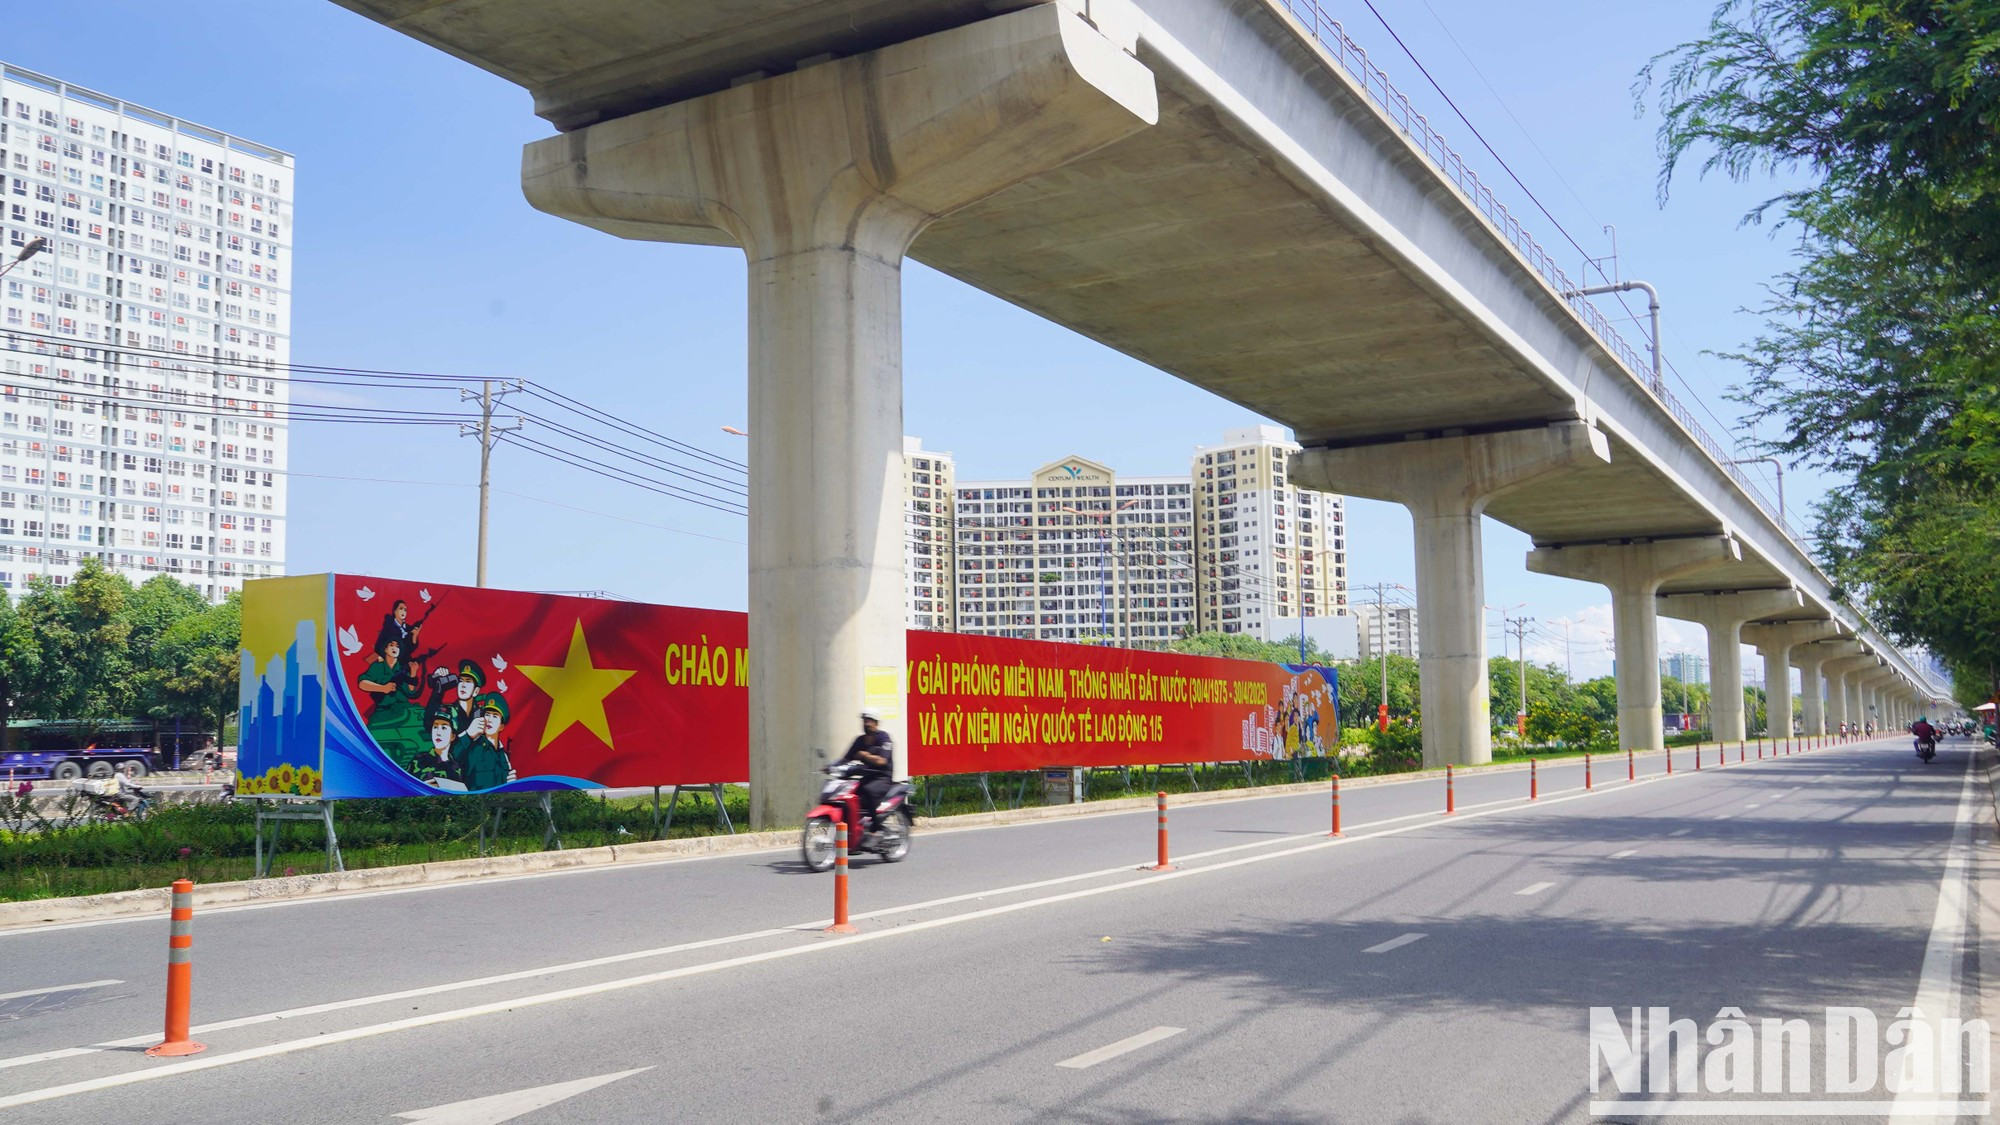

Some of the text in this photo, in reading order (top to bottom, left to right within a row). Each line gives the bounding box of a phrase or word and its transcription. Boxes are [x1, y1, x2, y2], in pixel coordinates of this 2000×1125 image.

[665, 634, 728, 687] CHÀO
[918, 653, 947, 695] GIẢI
[952, 655, 1000, 696] PHÓNG
[1004, 659, 1034, 697] MIỀN
[1038, 667, 1067, 703] NAM,
[1069, 664, 1107, 699] THỐNG
[1110, 666, 1136, 700] NHẤT
[1138, 669, 1158, 701] ĐẤT
[1160, 670, 1187, 702] NƯỚC
[919, 703, 1163, 752] VÀ KỶ NIỆM NGÀY QUỐC TẾ LAO ĐỘNG 1/5
